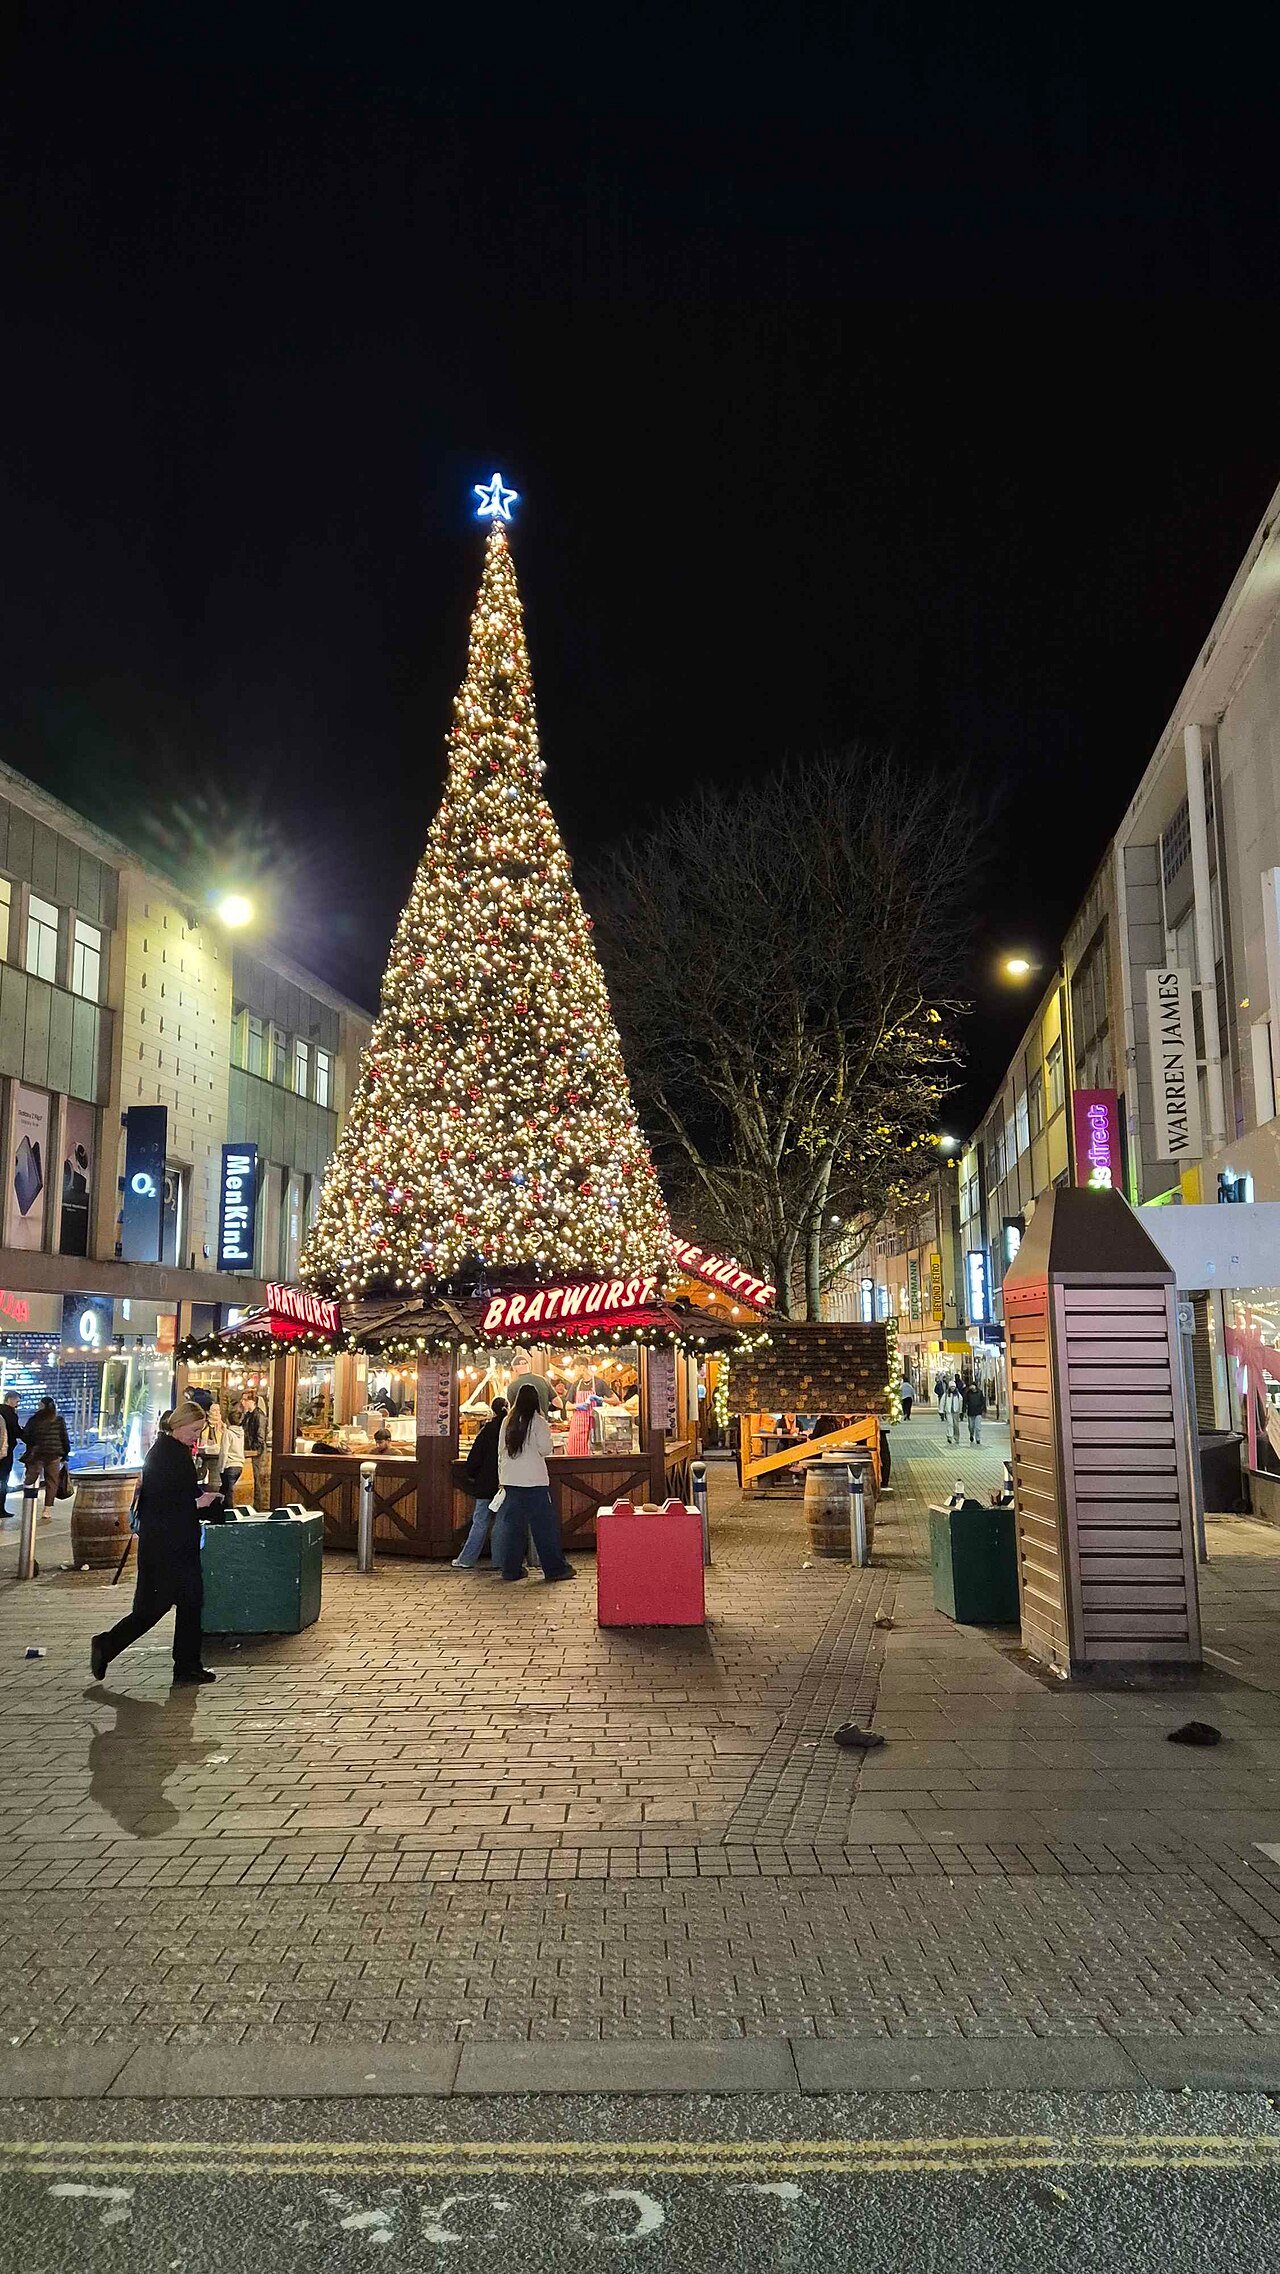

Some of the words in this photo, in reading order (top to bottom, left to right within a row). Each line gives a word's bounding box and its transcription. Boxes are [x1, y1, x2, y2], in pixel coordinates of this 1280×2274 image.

[1158, 973, 1185, 1047] JAMES
[1163, 1054, 1190, 1154] WARREN
[266, 1282, 339, 1331] BRATWURST
[483, 1276, 658, 1330] BRATWURST
[910, 1260, 919, 1320] DEICHMANN
[933, 1285, 942, 1312] BEYOND
